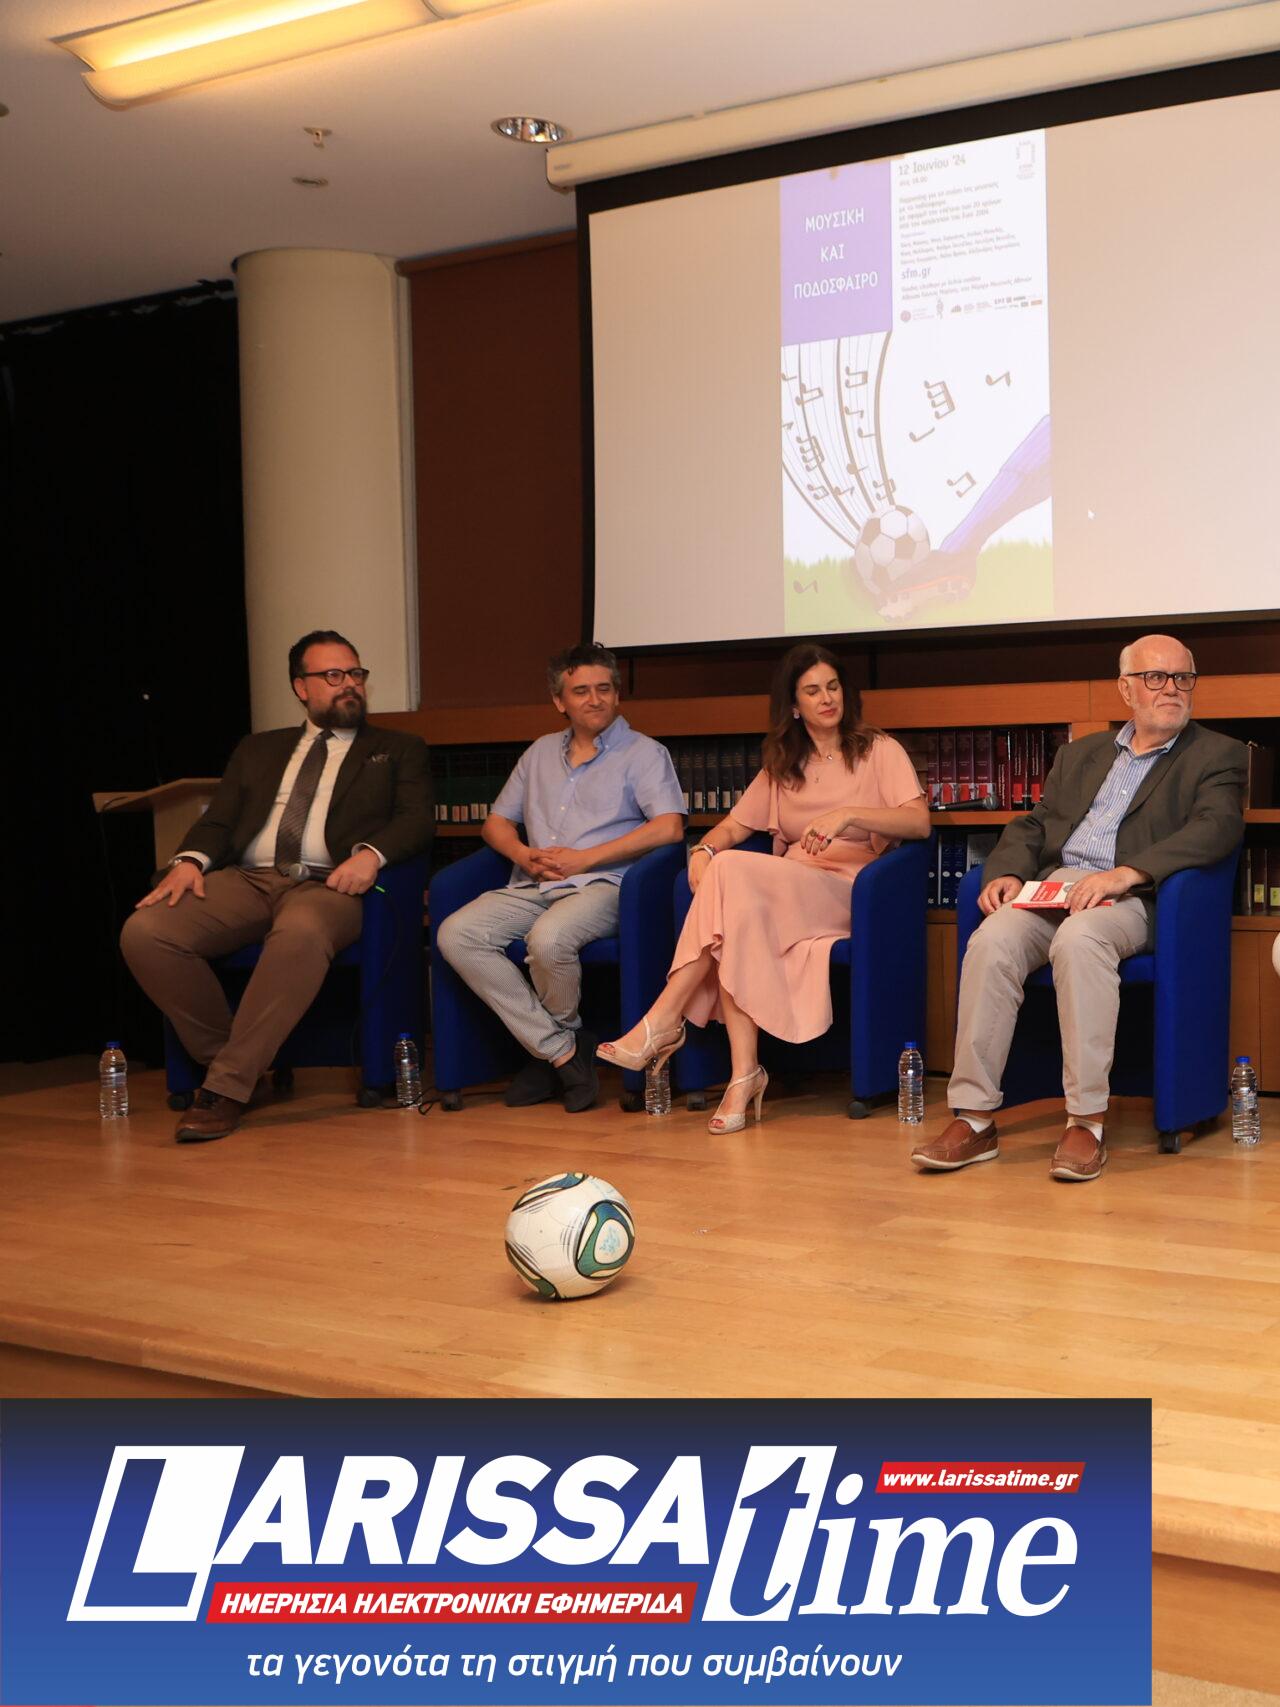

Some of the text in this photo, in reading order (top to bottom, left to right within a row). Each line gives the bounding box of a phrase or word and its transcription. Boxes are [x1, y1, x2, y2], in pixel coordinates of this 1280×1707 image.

[898, 164, 910, 176] 12
[913, 157, 949, 174] Ιουνίου
[805, 207, 864, 232] ΜΟΥΣΙΚΗ
[820, 243, 845, 263] ΚΑΙ
[901, 266, 931, 280] sfm.gr
[794, 270, 879, 299] ΠΟΔΟΣΦΑΙΡΟ
